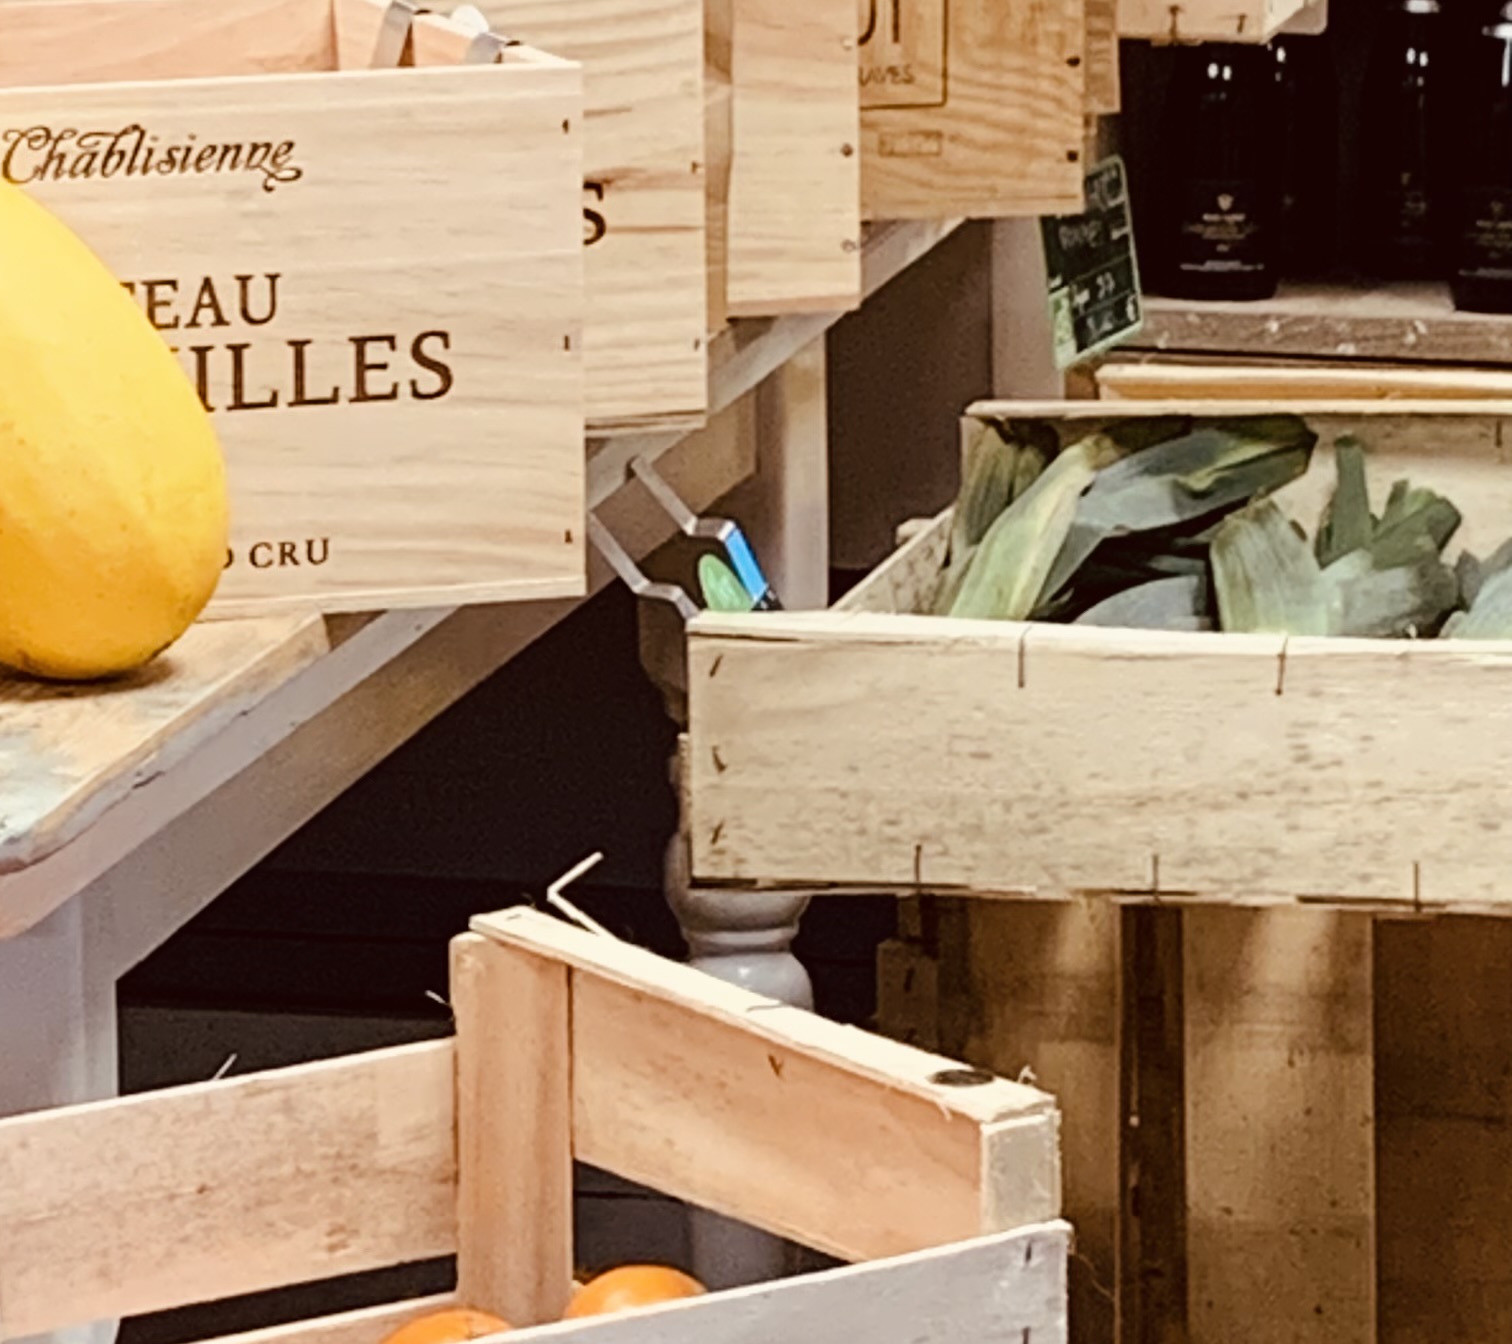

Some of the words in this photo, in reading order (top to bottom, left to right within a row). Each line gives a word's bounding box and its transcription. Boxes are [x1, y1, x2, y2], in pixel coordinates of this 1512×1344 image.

[1, 123, 303, 192] Chablisienne
[170, 330, 454, 413] ILLES
[249, 537, 330, 568] CRU
